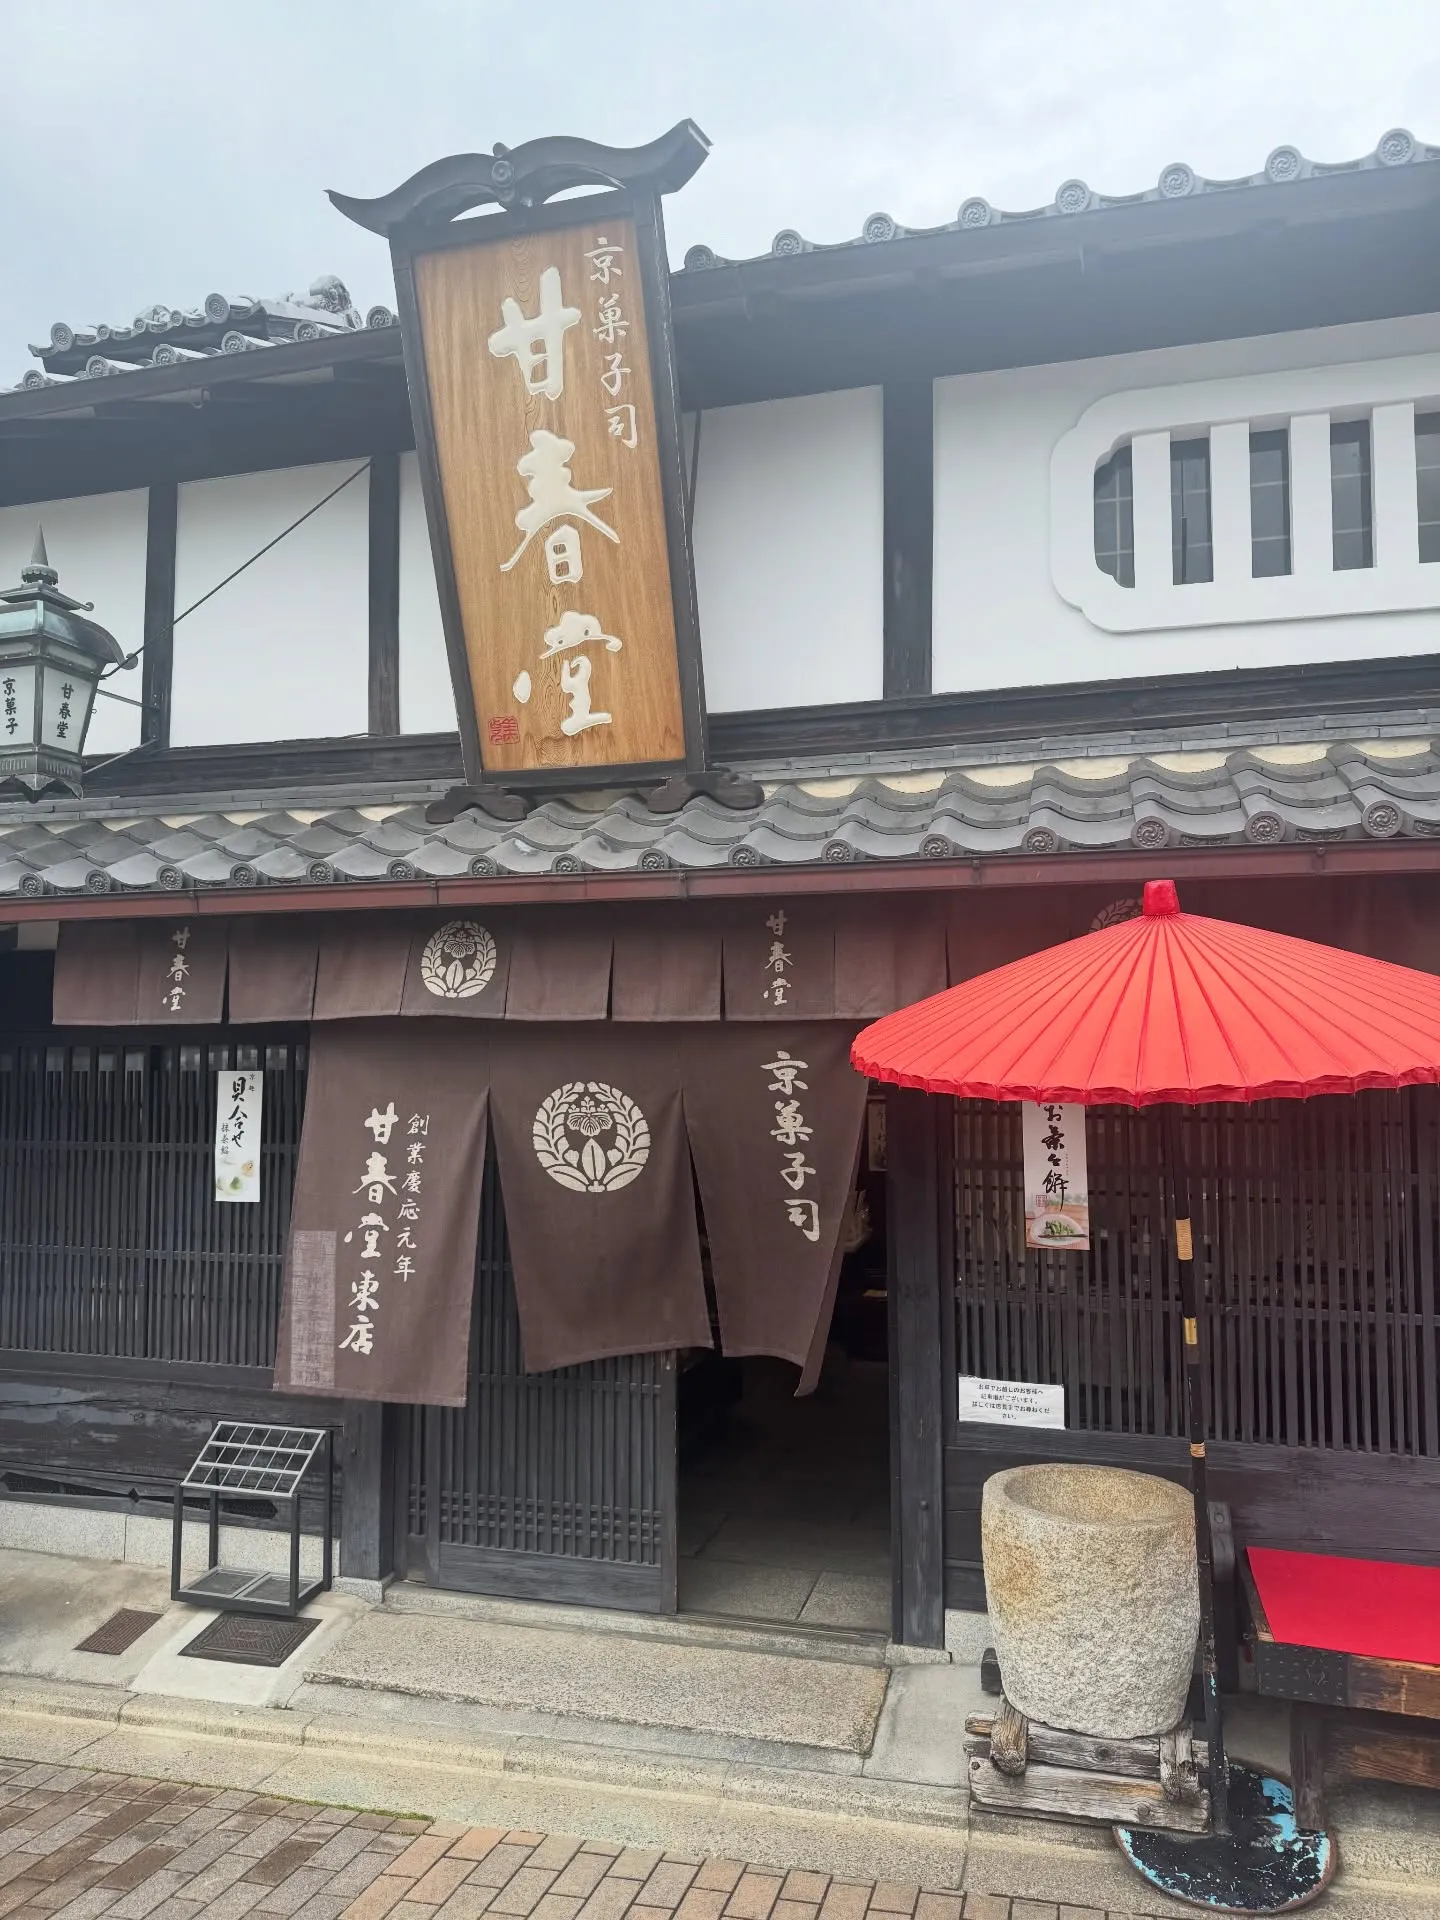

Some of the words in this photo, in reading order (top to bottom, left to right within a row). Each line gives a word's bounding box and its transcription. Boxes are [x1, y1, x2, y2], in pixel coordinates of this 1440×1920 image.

[584, 236, 639, 449] 京菓子司
[488, 266, 622, 735] 甘春堂
[2, 677, 19, 735] 京菓子
[56, 683, 74, 739] 甘春堂
[162, 926, 191, 1011] 甘春堂
[762, 909, 794, 1006] 甘春堂
[228, 1076, 248, 1148] 貝合せ
[760, 1050, 820, 1242] 京菓子司
[338, 1102, 400, 1355] 甘春堂東店
[393, 1113, 430, 1283] 創業慶応元年
